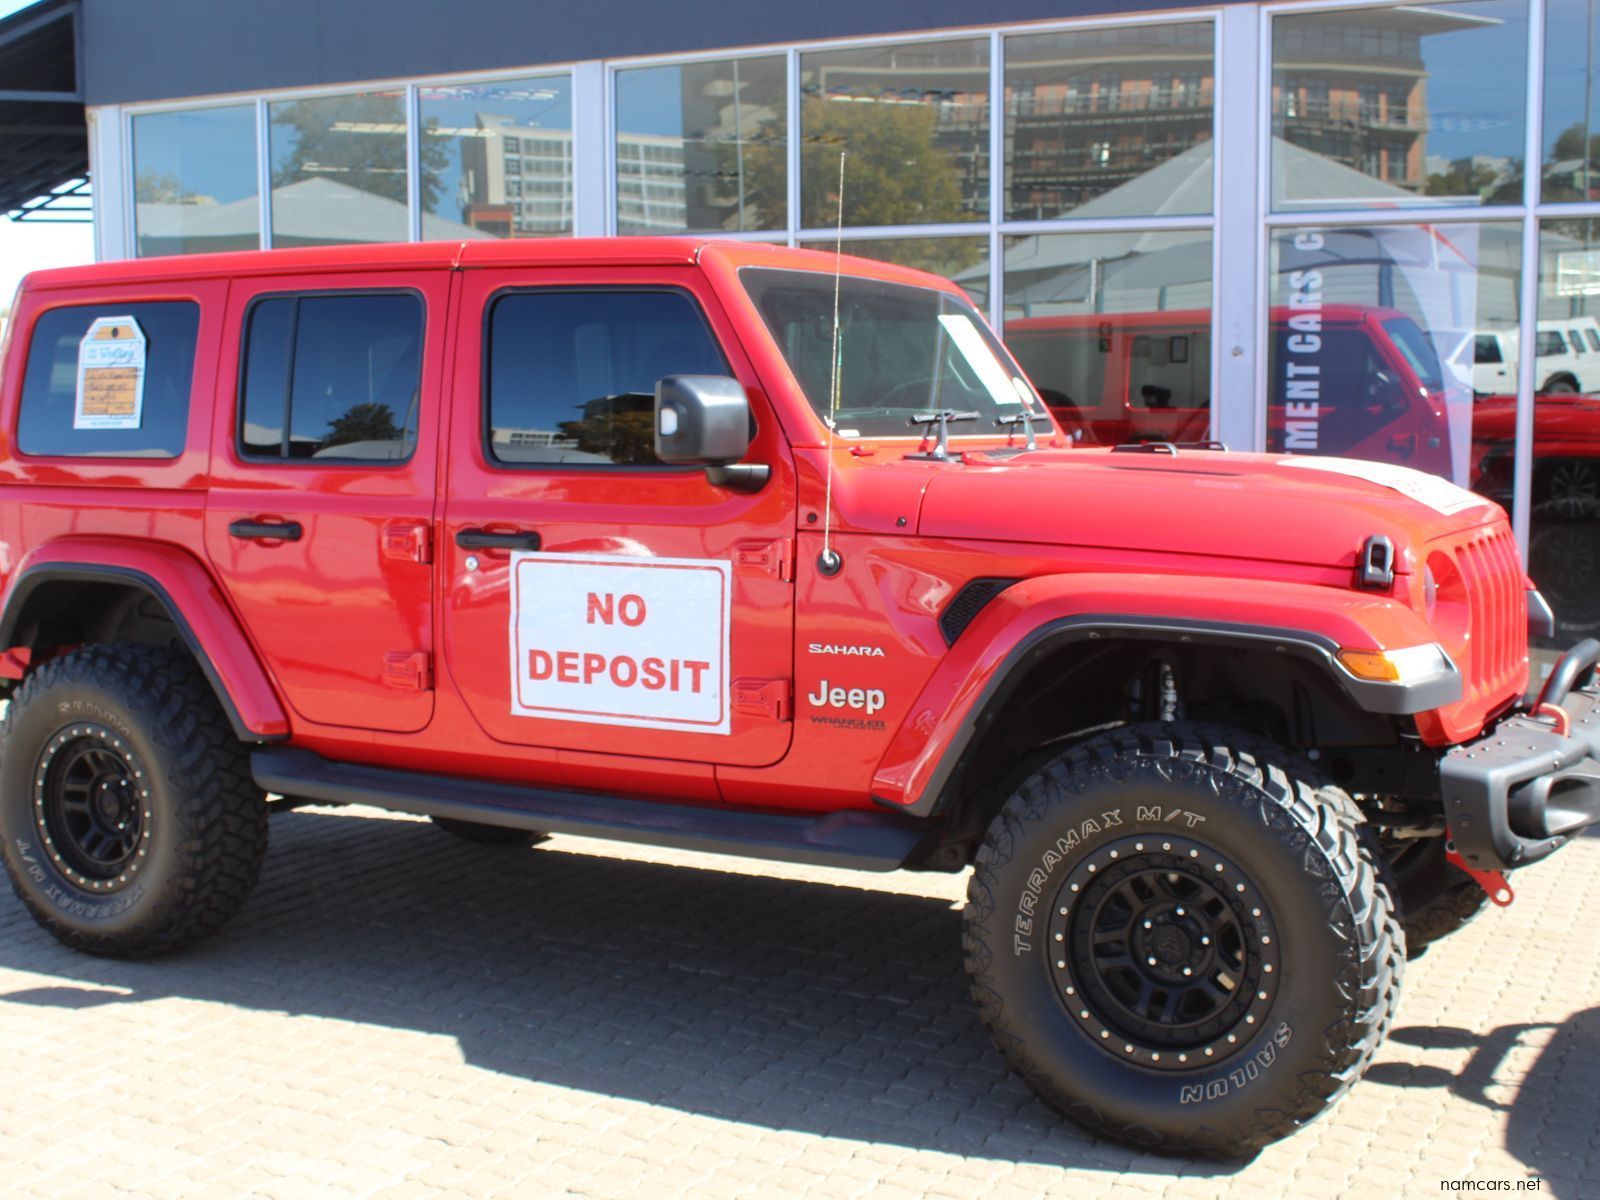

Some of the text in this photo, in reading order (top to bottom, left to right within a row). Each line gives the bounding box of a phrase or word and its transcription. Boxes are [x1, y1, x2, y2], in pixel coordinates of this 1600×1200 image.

[1287, 270, 1324, 354] CARS
[1284, 362, 1321, 454] MENT
[586, 592, 646, 627] NO
[528, 649, 710, 693] DEPOSIT
[808, 643, 885, 657] SAHARA
[808, 680, 885, 714] Jeep
[1014, 805, 1206, 956] TERRAMAX M/T
[1179, 1021, 1293, 1105] SAILUN
